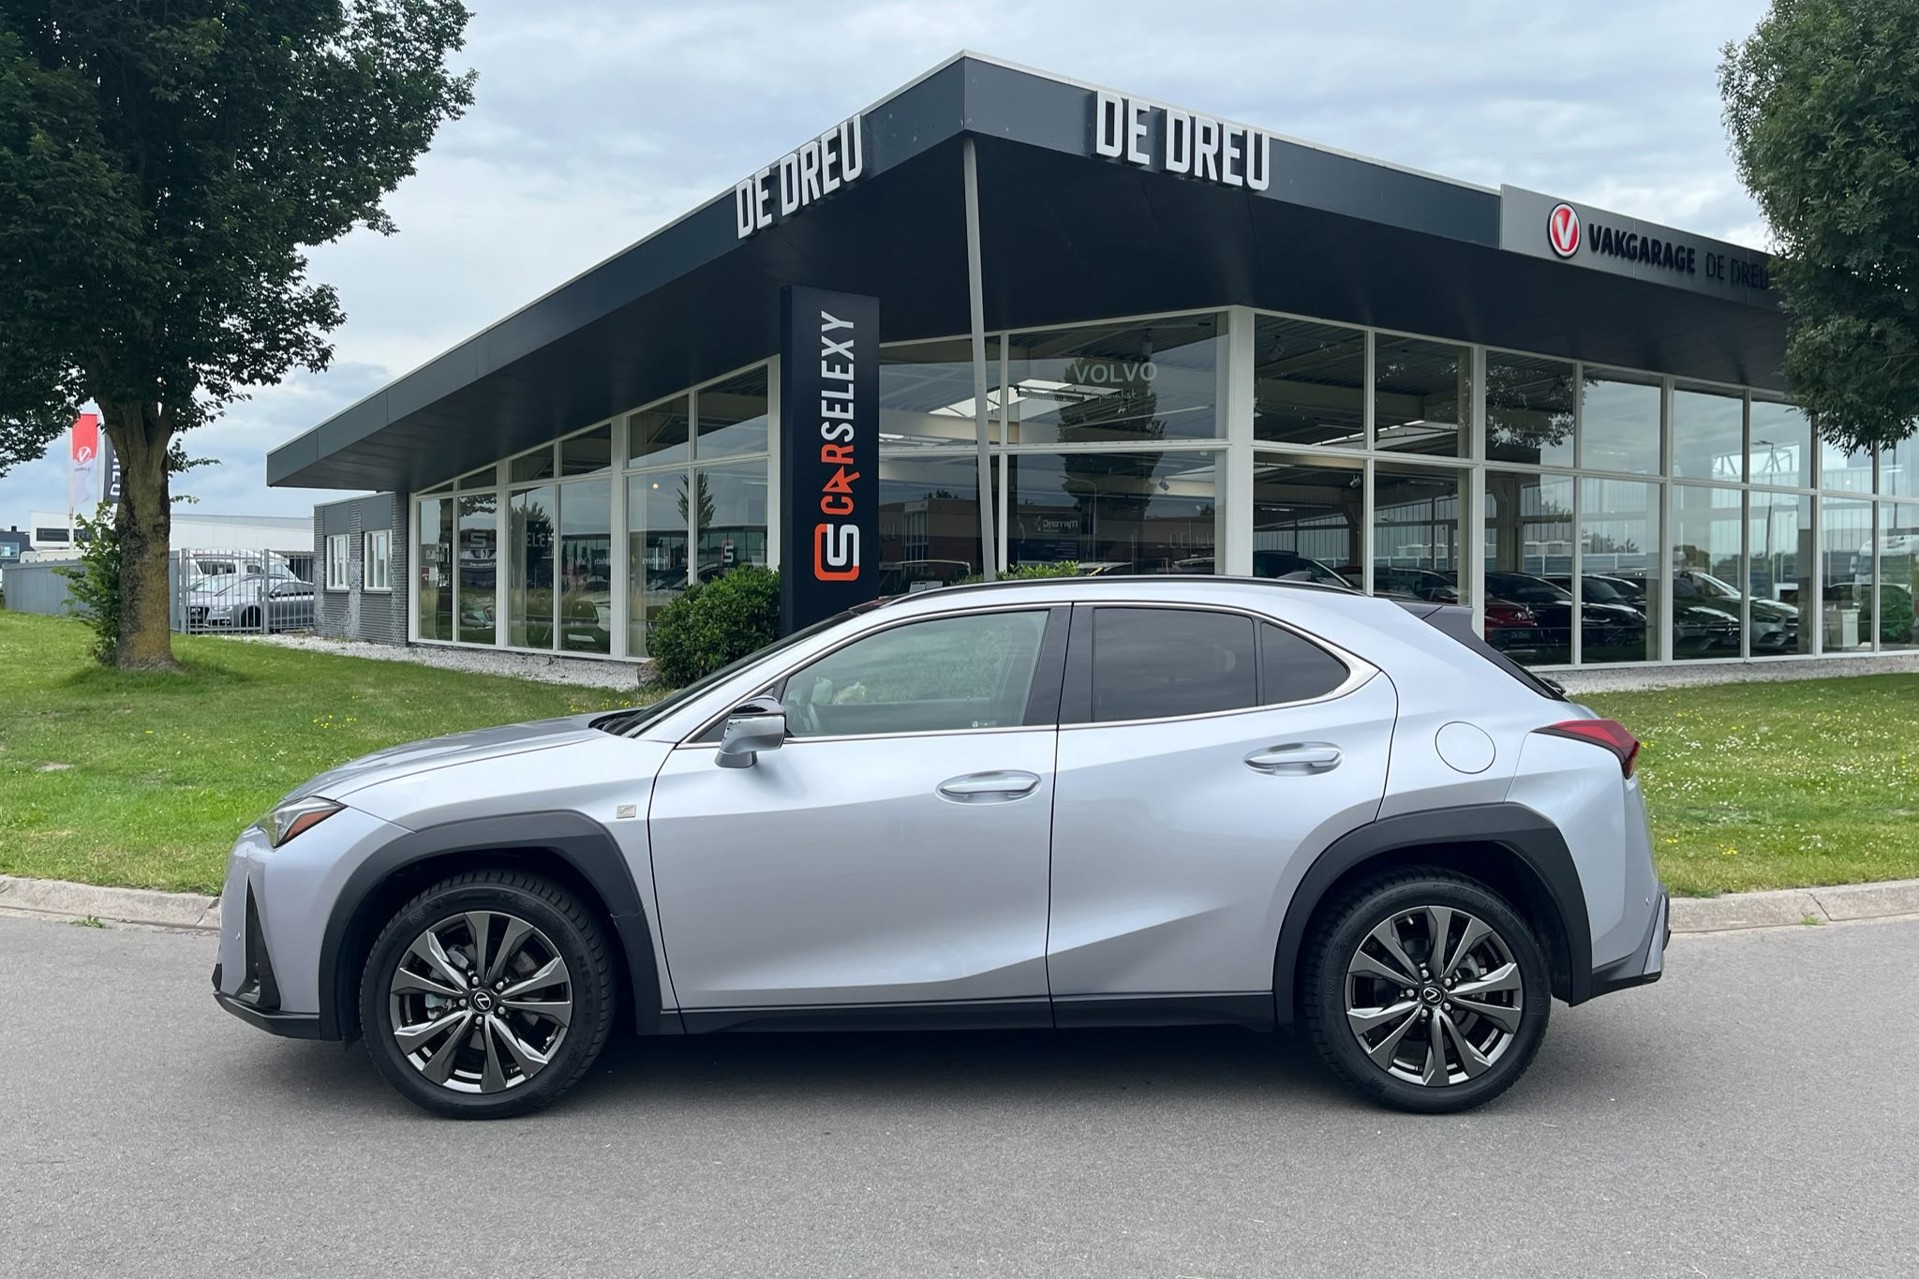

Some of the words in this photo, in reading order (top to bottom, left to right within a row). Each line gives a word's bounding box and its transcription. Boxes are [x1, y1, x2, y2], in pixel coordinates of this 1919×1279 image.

[736, 166, 772, 239] DE
[780, 113, 863, 216] DREU
[1096, 90, 1150, 165] DE
[1166, 108, 1270, 191] DREU
[1588, 223, 1696, 274] VAKGARAGE
[1706, 251, 1725, 281] DE
[1730, 258, 1769, 290] DREU
[821, 310, 860, 515] CARSELEXY
[1073, 362, 1158, 384] VOLVO
